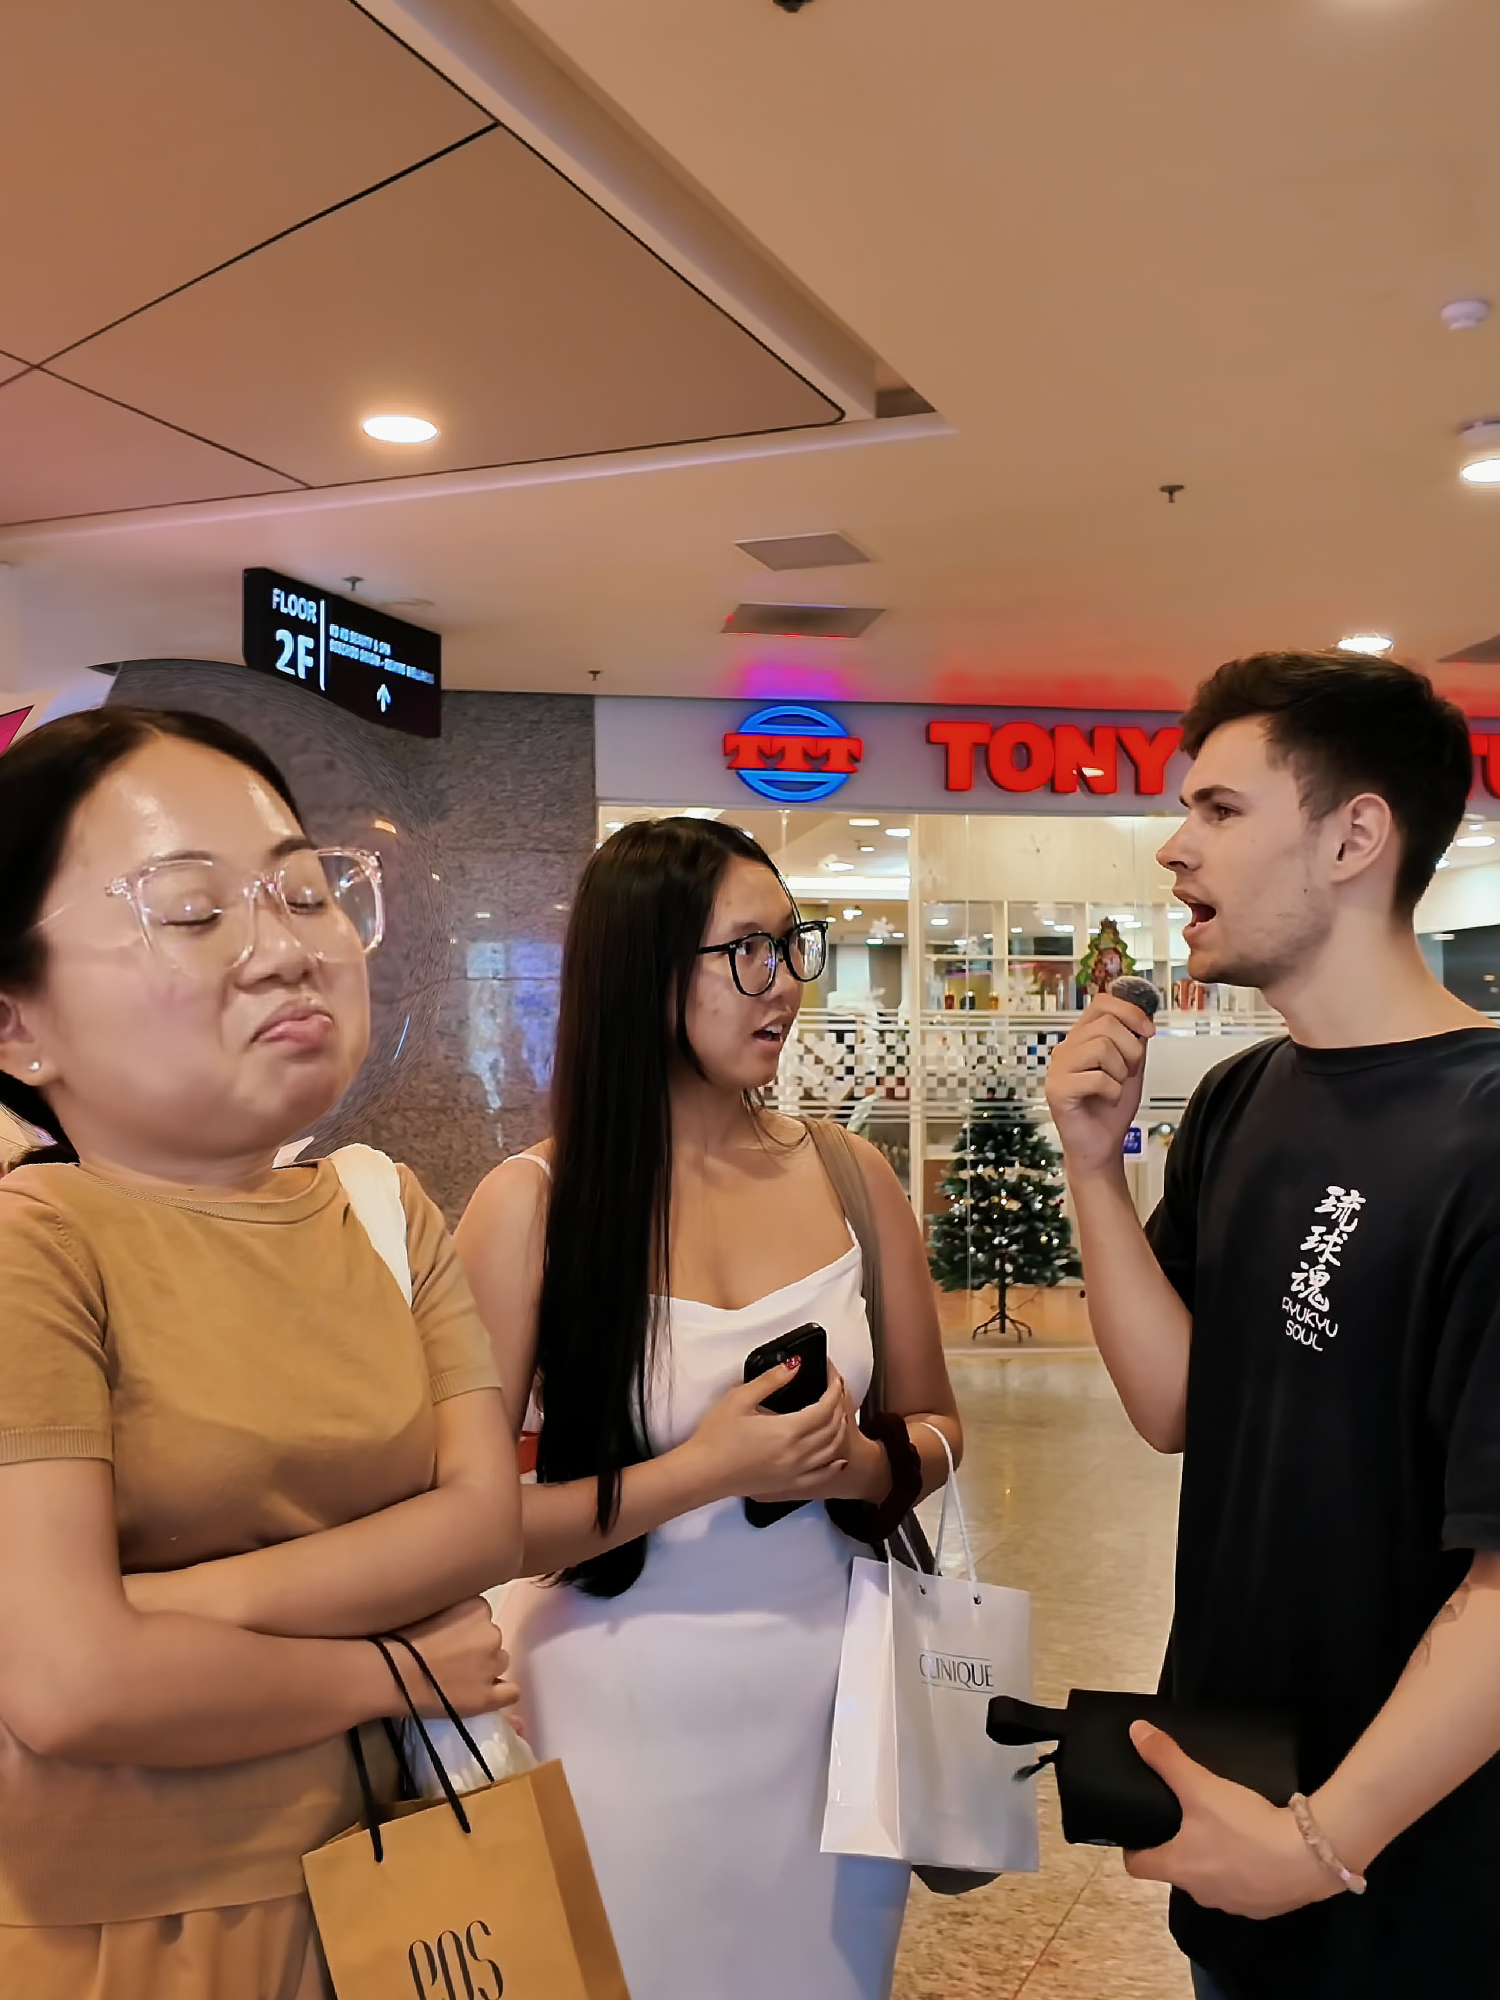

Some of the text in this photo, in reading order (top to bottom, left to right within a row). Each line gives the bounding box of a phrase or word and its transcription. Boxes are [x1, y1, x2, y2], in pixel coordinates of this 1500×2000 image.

[272, 587, 317, 624] FLOOR
[275, 629, 315, 680] 2F
[926, 720, 1184, 797] TONY
[1290, 1185, 1367, 1312] 琉球魂
[1282, 1296, 1339, 1338] RYUKYU
[1285, 1319, 1324, 1352] SOUL
[919, 1653, 994, 1688] CLINIQUE
